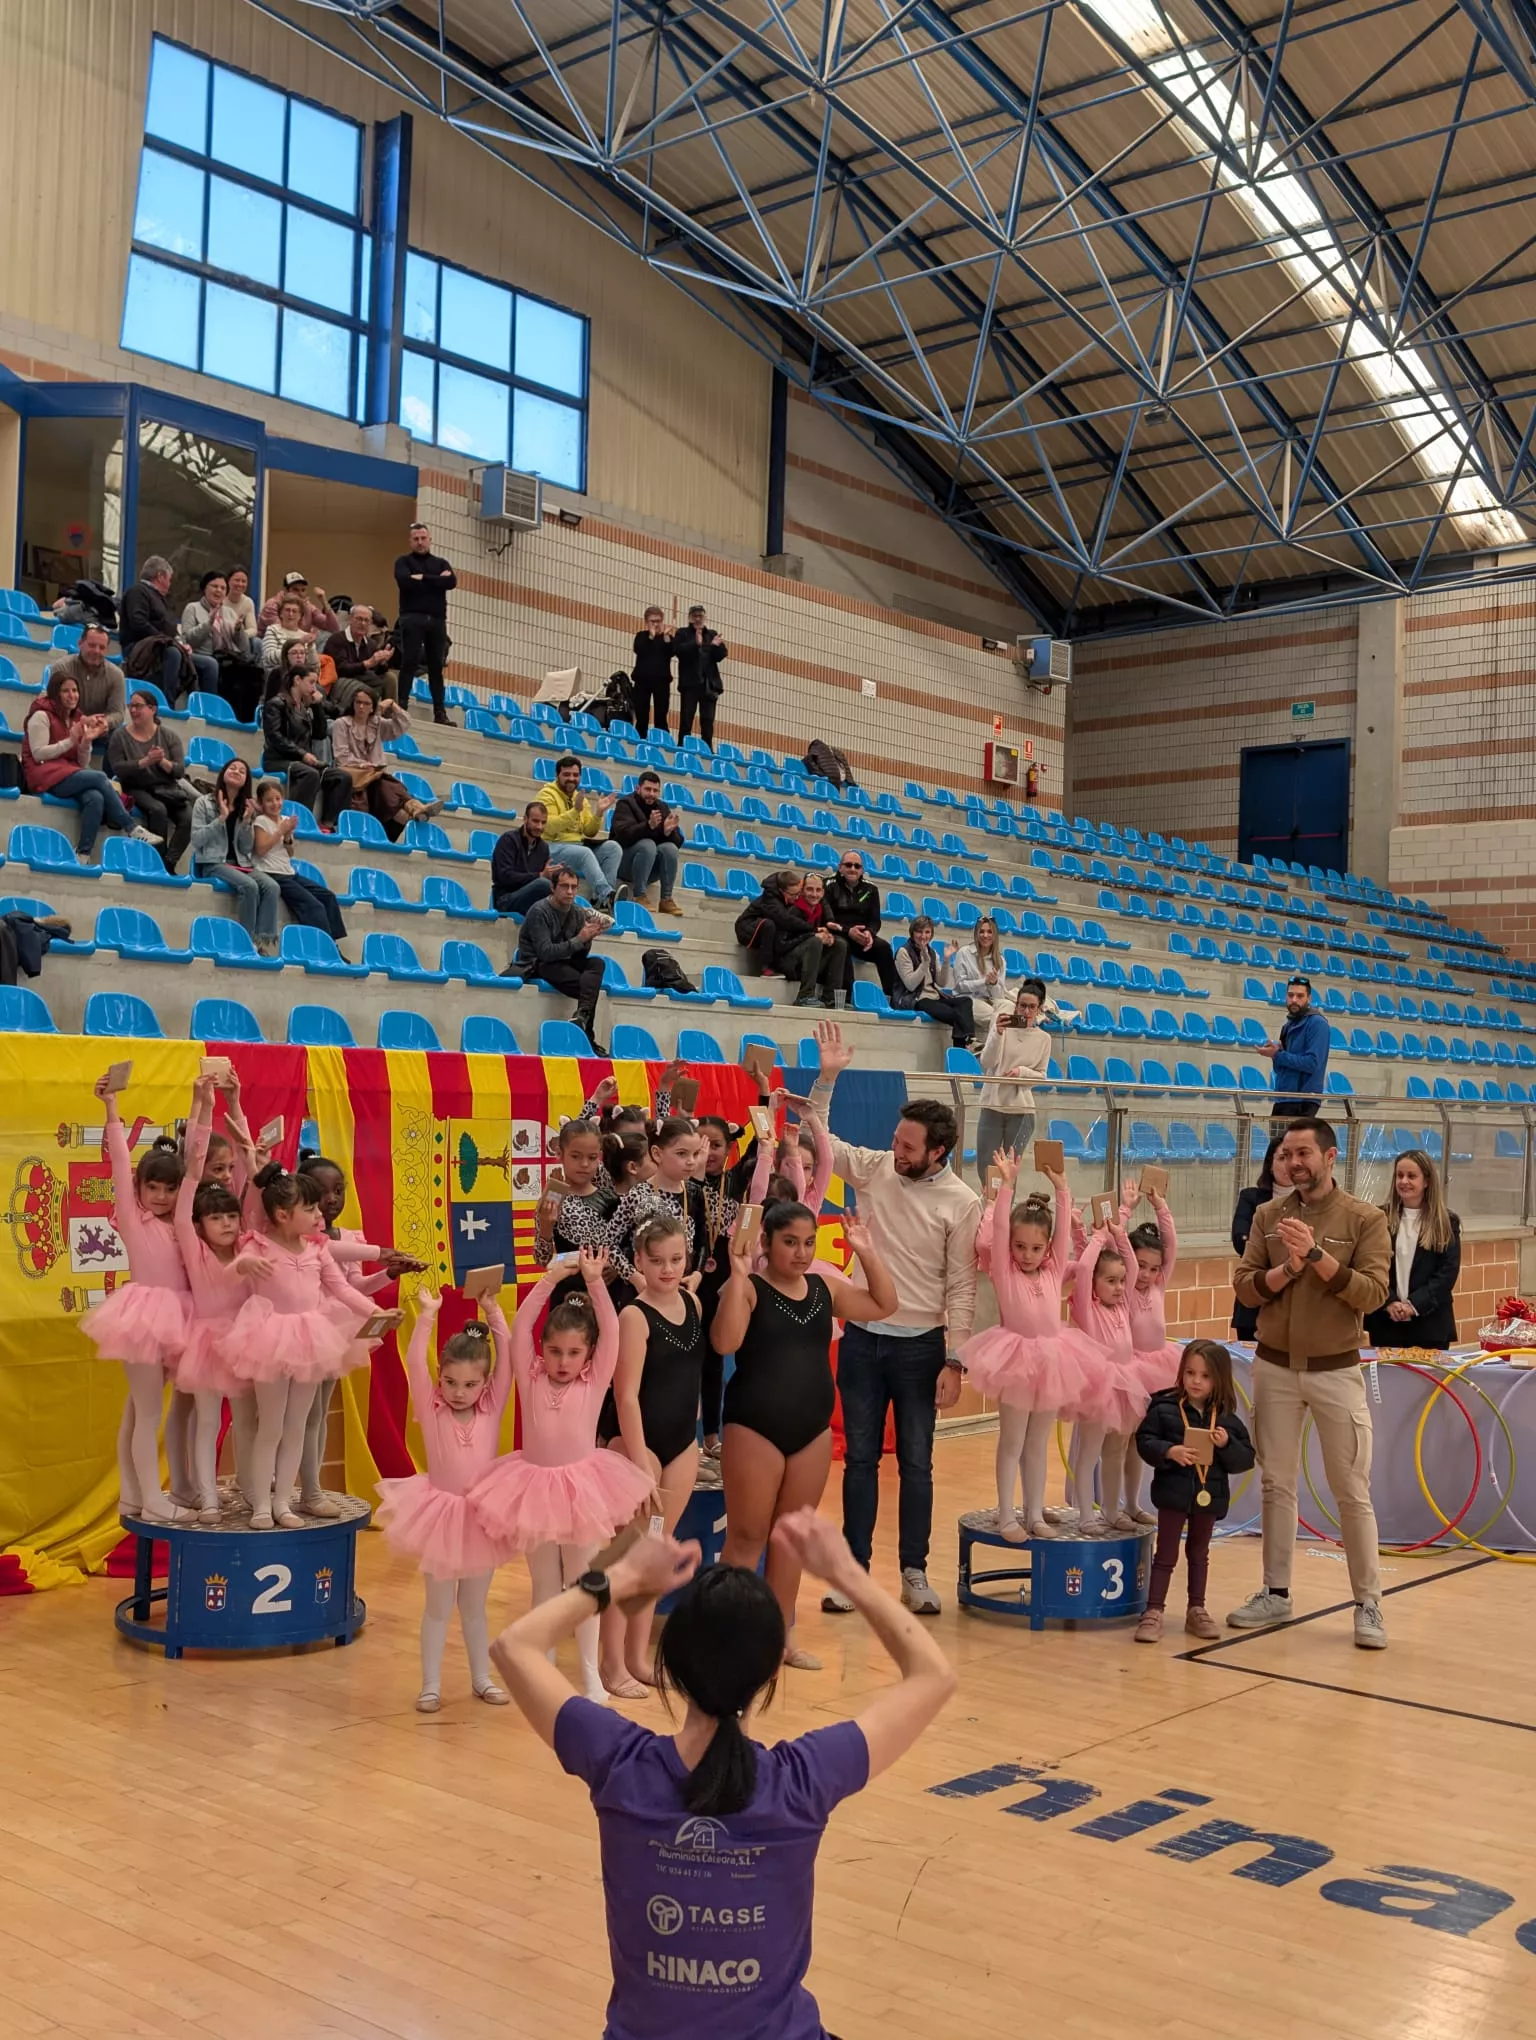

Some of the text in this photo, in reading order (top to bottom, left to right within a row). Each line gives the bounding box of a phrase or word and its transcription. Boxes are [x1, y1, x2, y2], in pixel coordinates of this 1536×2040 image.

[251, 1563, 293, 1615] 2
[1100, 1558, 1124, 1600] 3
[687, 1905, 766, 1925] TAGSE
[647, 1951, 761, 1986] HINACO
